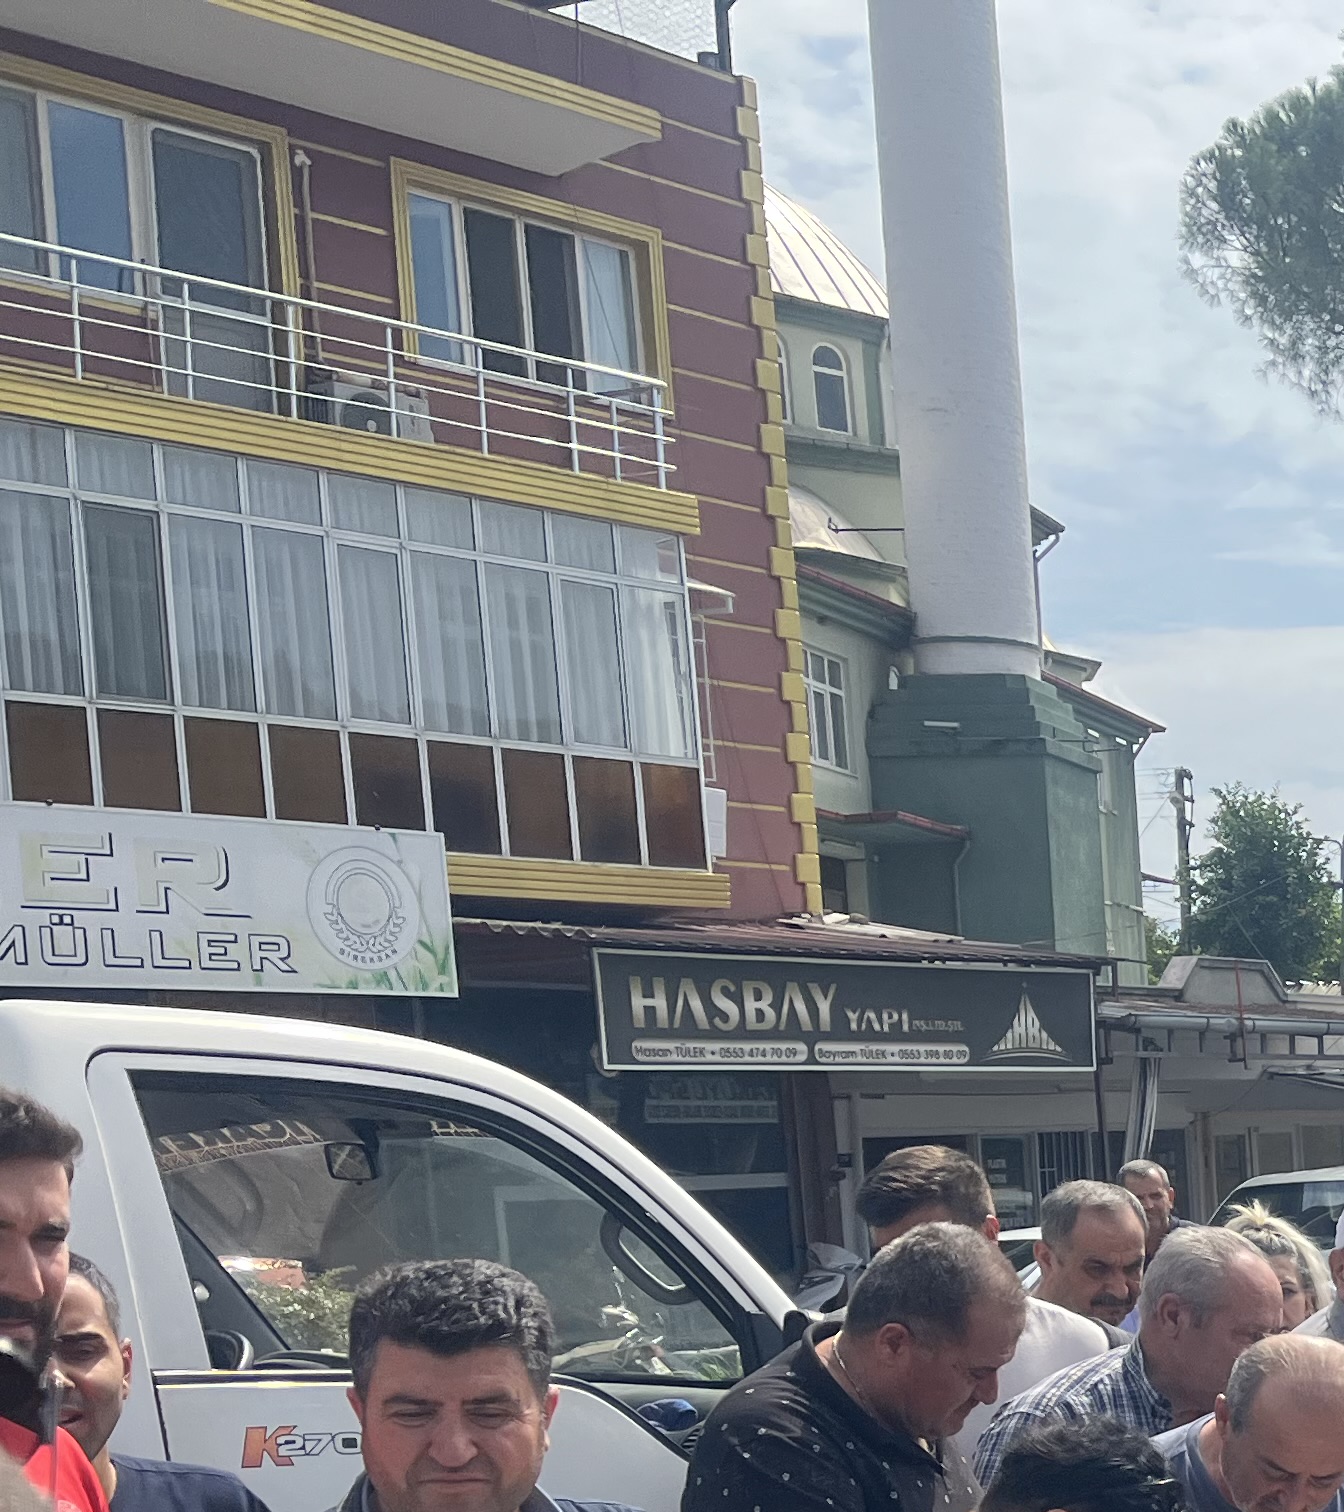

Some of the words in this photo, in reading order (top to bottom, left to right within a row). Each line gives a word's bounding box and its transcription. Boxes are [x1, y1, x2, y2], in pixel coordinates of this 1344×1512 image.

[628, 975, 838, 1032] HASBAY
[844, 1007, 910, 1033] YAPI
[633, 1046, 672, 1058] Hasan
[818, 1047, 857, 1062] Bayram
